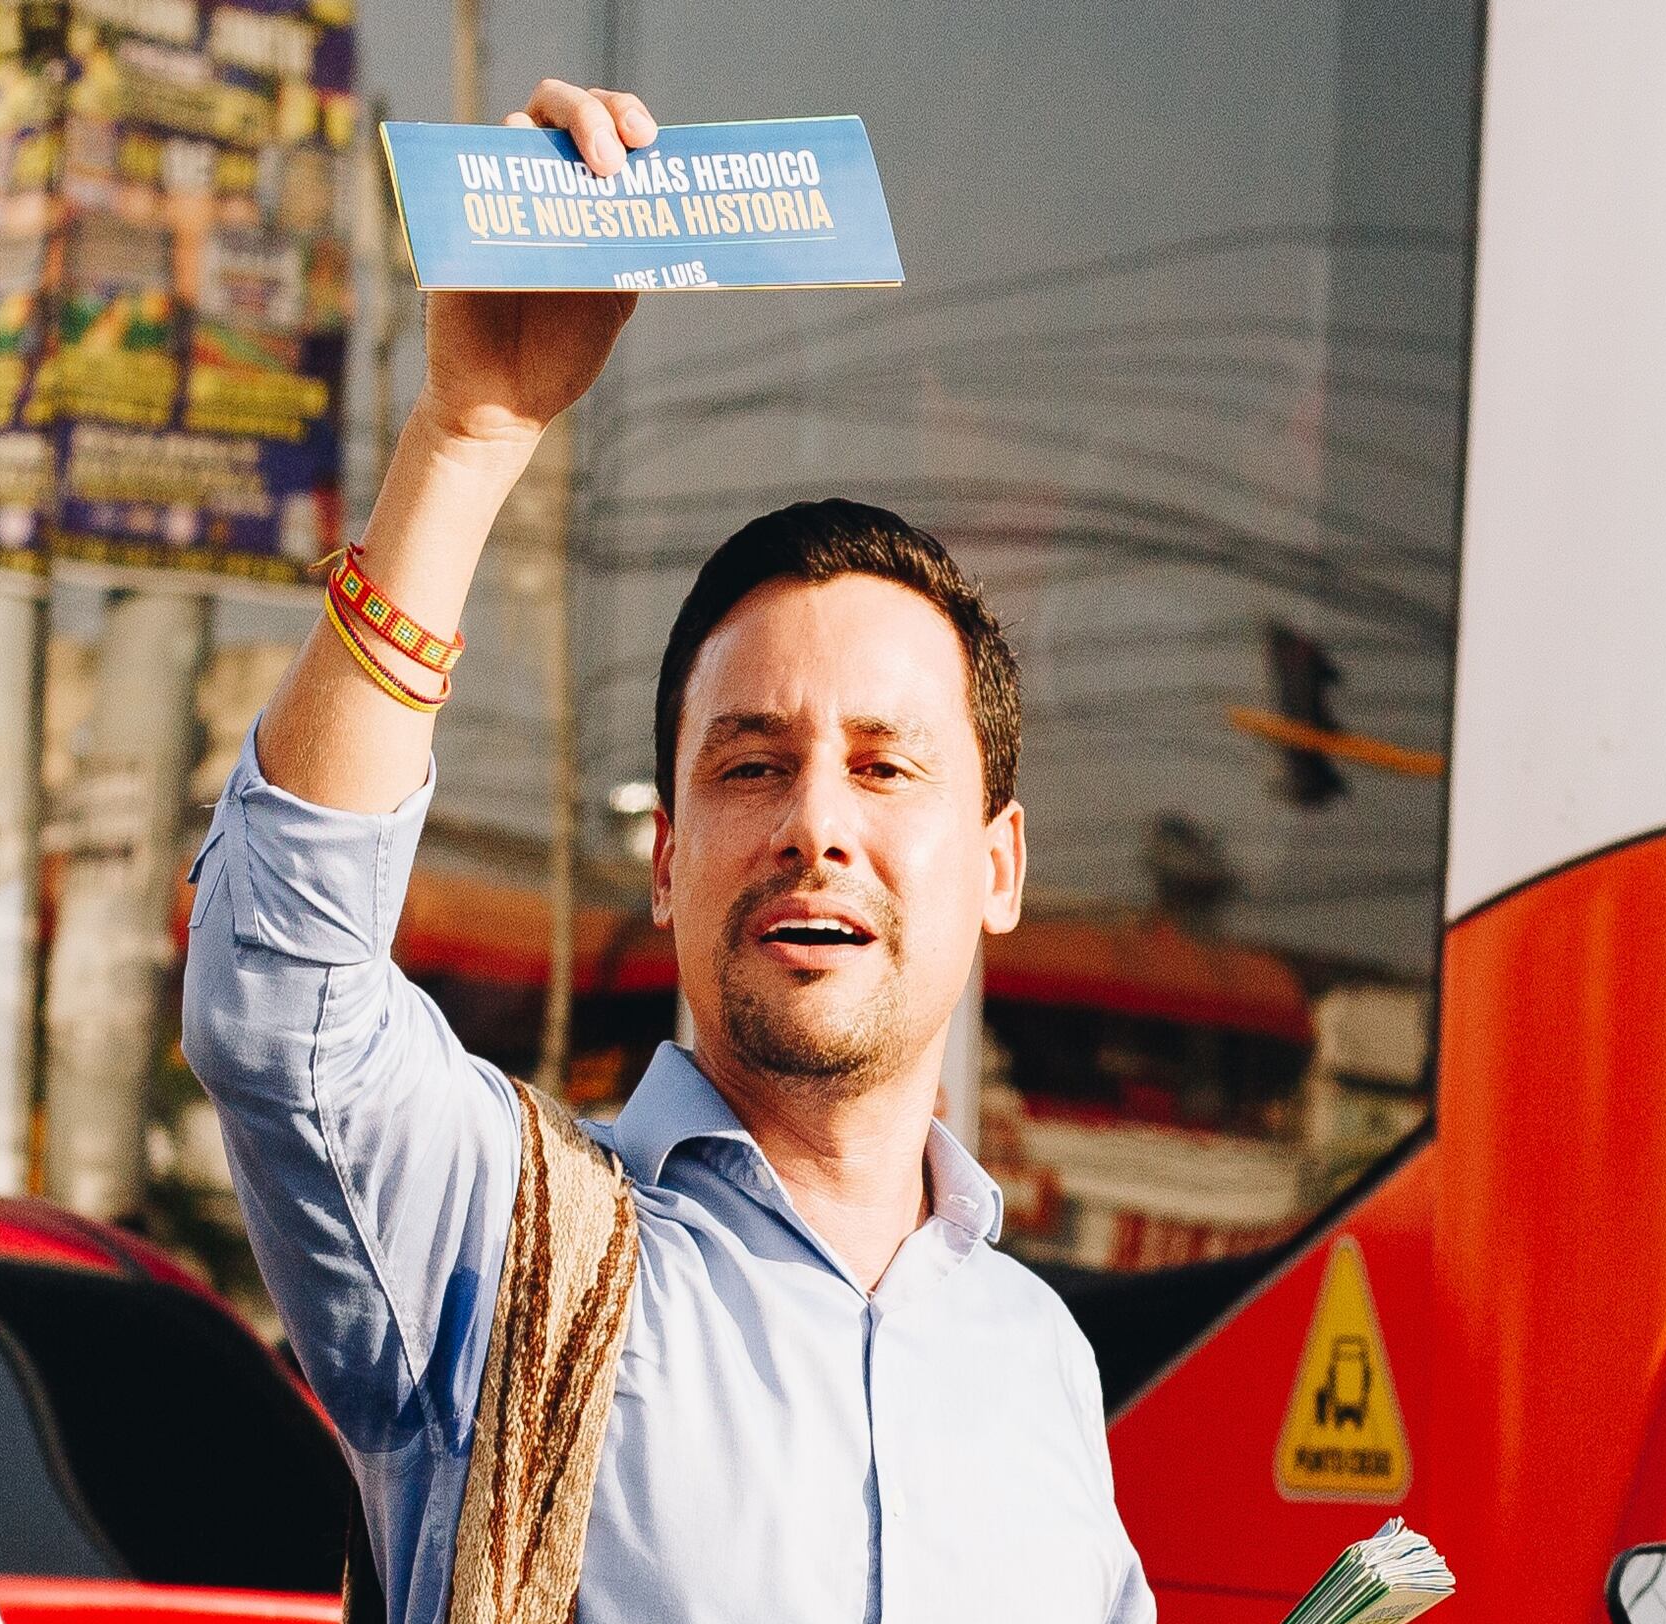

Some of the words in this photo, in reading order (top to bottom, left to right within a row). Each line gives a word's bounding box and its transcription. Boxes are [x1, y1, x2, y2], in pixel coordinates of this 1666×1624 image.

[458, 153, 504, 192] UN
[621, 150, 691, 196] MÁS
[691, 150, 821, 192] HEROICO
[463, 192, 531, 239] QUE
[532, 196, 681, 238] NUESTRA
[681, 189, 835, 236] HISTORIA
[661, 260, 708, 289] LUIS
